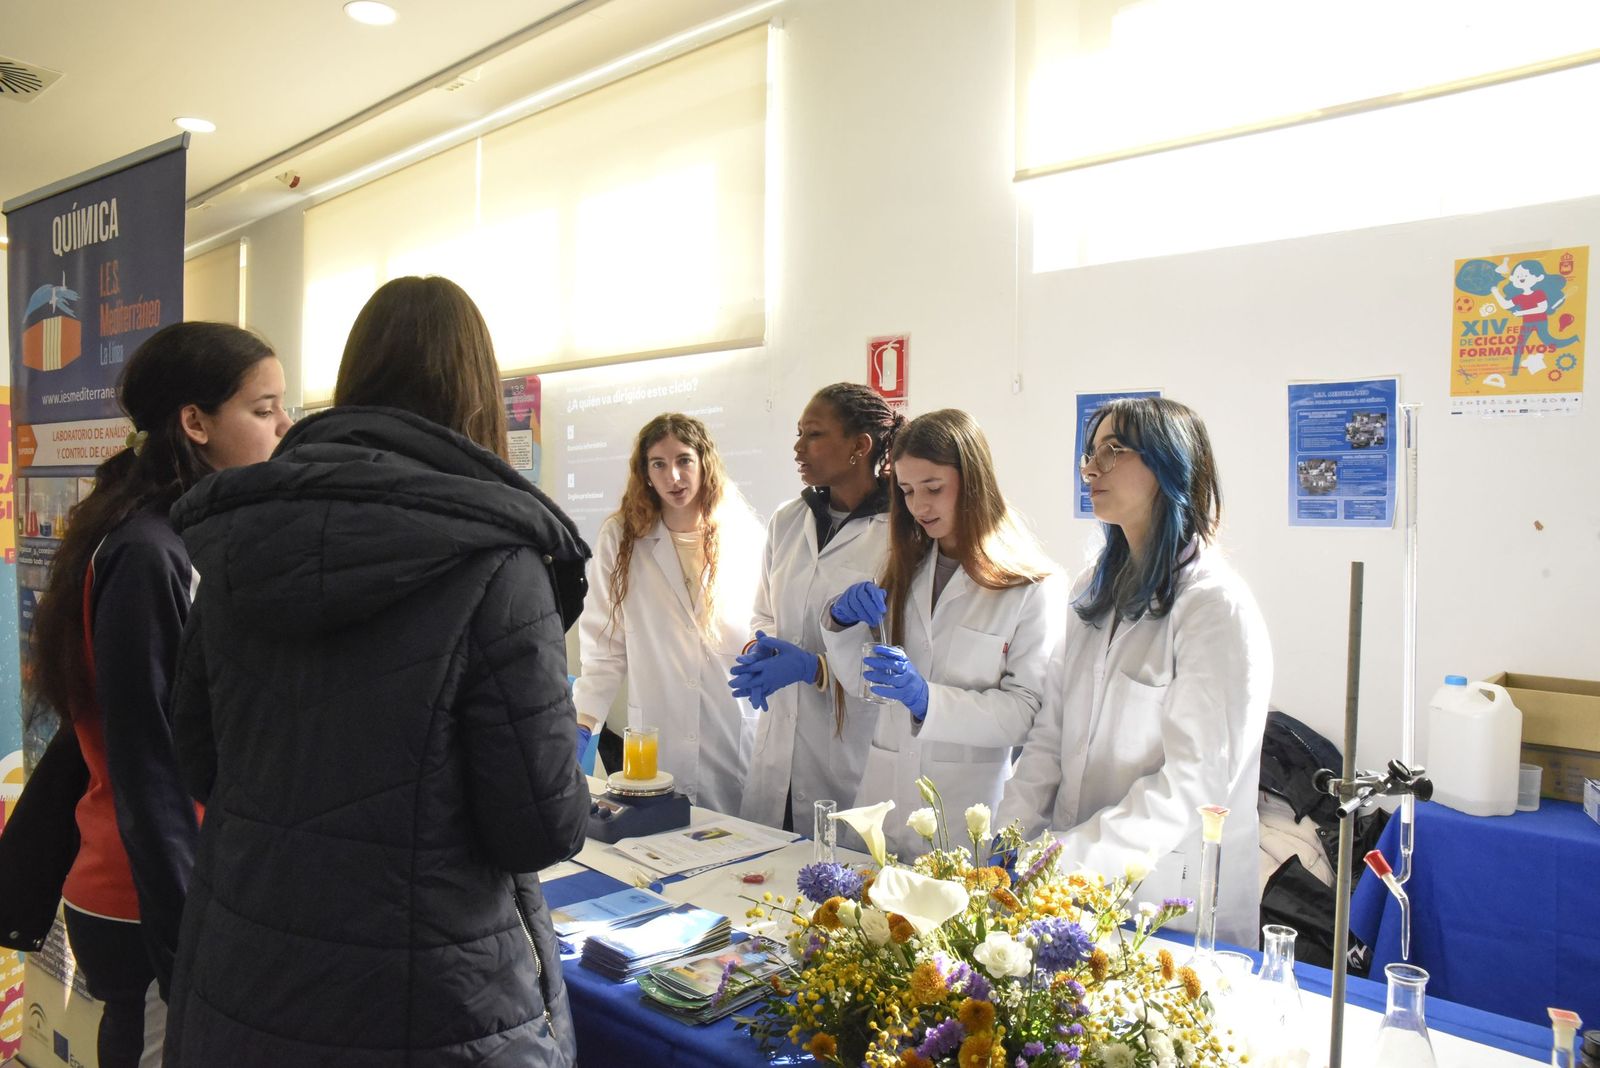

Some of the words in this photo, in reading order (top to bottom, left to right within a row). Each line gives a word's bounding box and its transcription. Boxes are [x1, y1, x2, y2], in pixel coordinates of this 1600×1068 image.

[52, 197, 119, 257] QUÍMICA
[99, 294, 160, 336] Mediterráneo
[1461, 318, 1509, 337] XIV
[1459, 338, 1473, 346] DE
[1474, 335, 1525, 346] CICLOS
[100, 344, 109, 366] La
[1459, 343, 1557, 358] FORMATIVOS
[567, 398, 578, 413] ¿A
[579, 394, 601, 412] quién
[602, 394, 612, 405] va
[613, 386, 646, 405] dirigido
[647, 385, 668, 399] este
[669, 377, 698, 393] ciclo?
[52, 428, 92, 442] LABORATORIO
[94, 427, 104, 440] DE
[105, 423, 131, 438] ANÁLISIS
[57, 448, 61, 460] Y
[61, 445, 88, 460] CONTROL
[89, 445, 100, 458] DE
